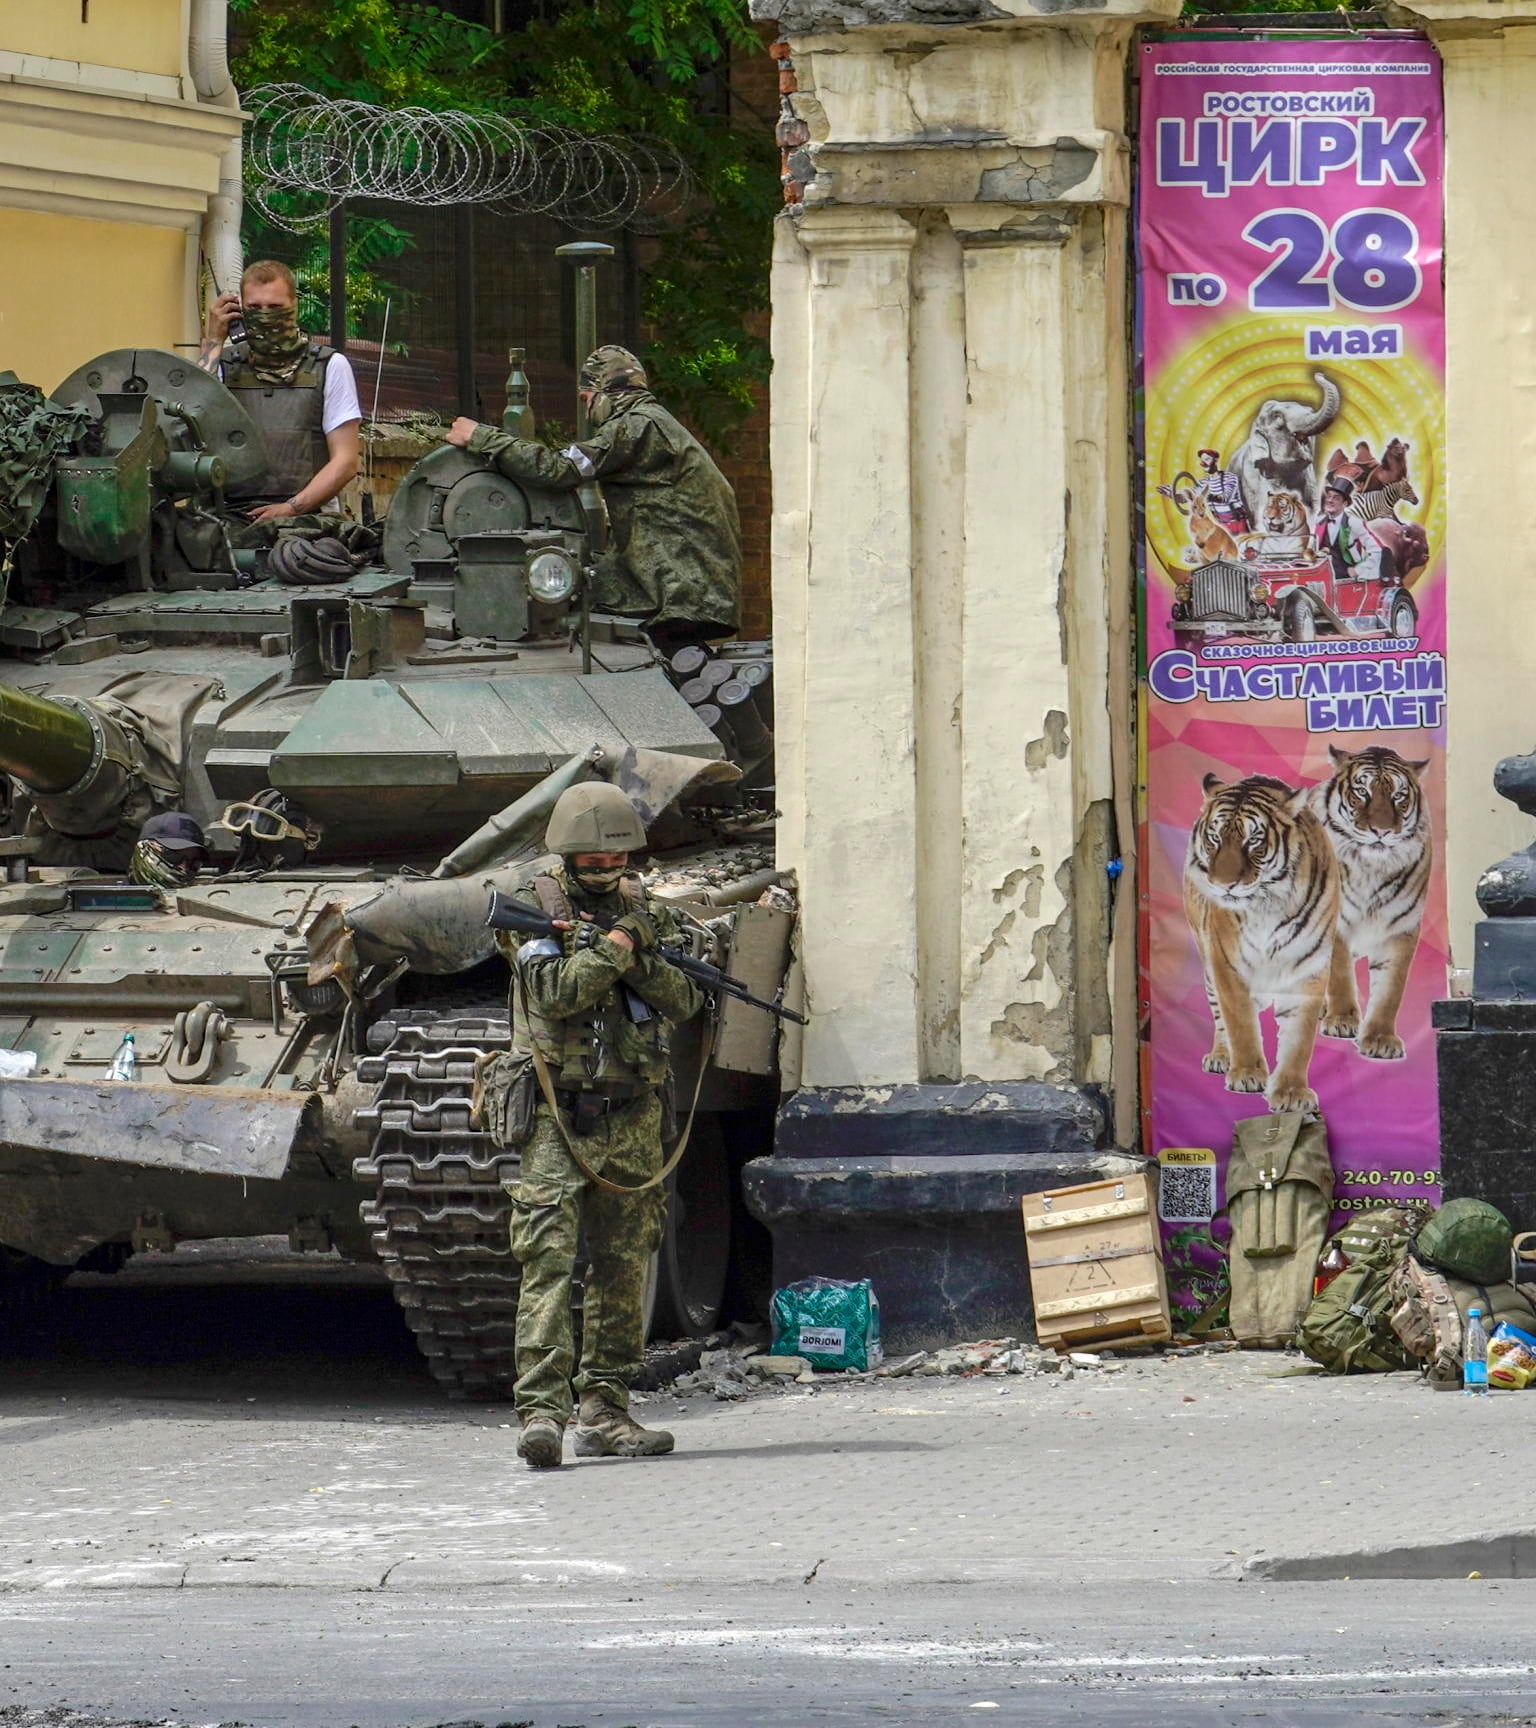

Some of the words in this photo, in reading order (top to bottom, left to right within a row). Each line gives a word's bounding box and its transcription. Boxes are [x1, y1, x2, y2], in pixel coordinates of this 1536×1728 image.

[1156, 62, 1220, 73] РОССИЙСКАЯ
[1223, 65, 1314, 74] ГОСУДАРСТВЕННАЯ
[1318, 65, 1372, 74] ЦИРКОВАЯ
[1374, 65, 1429, 73] КОМПАНИЯ
[1206, 91, 1371, 114] РОСТОВСКИЙ
[1158, 120, 1423, 195] ЦИРК
[1170, 276, 1223, 302] по
[1245, 211, 1418, 309] 28
[1308, 328, 1399, 357] мая
[1202, 644, 1294, 659] СКАЗОЧНОЕ
[1297, 639, 1380, 657] ЦИРКОВОЕ
[1381, 637, 1419, 652] ШОУ
[1309, 694, 1445, 730] БИЛЕТ
[1166, 1152, 1208, 1162] БИЛЕТЫ
[1086, 1265, 1096, 1280] 2
[801, 1335, 842, 1347] BORJOMI
